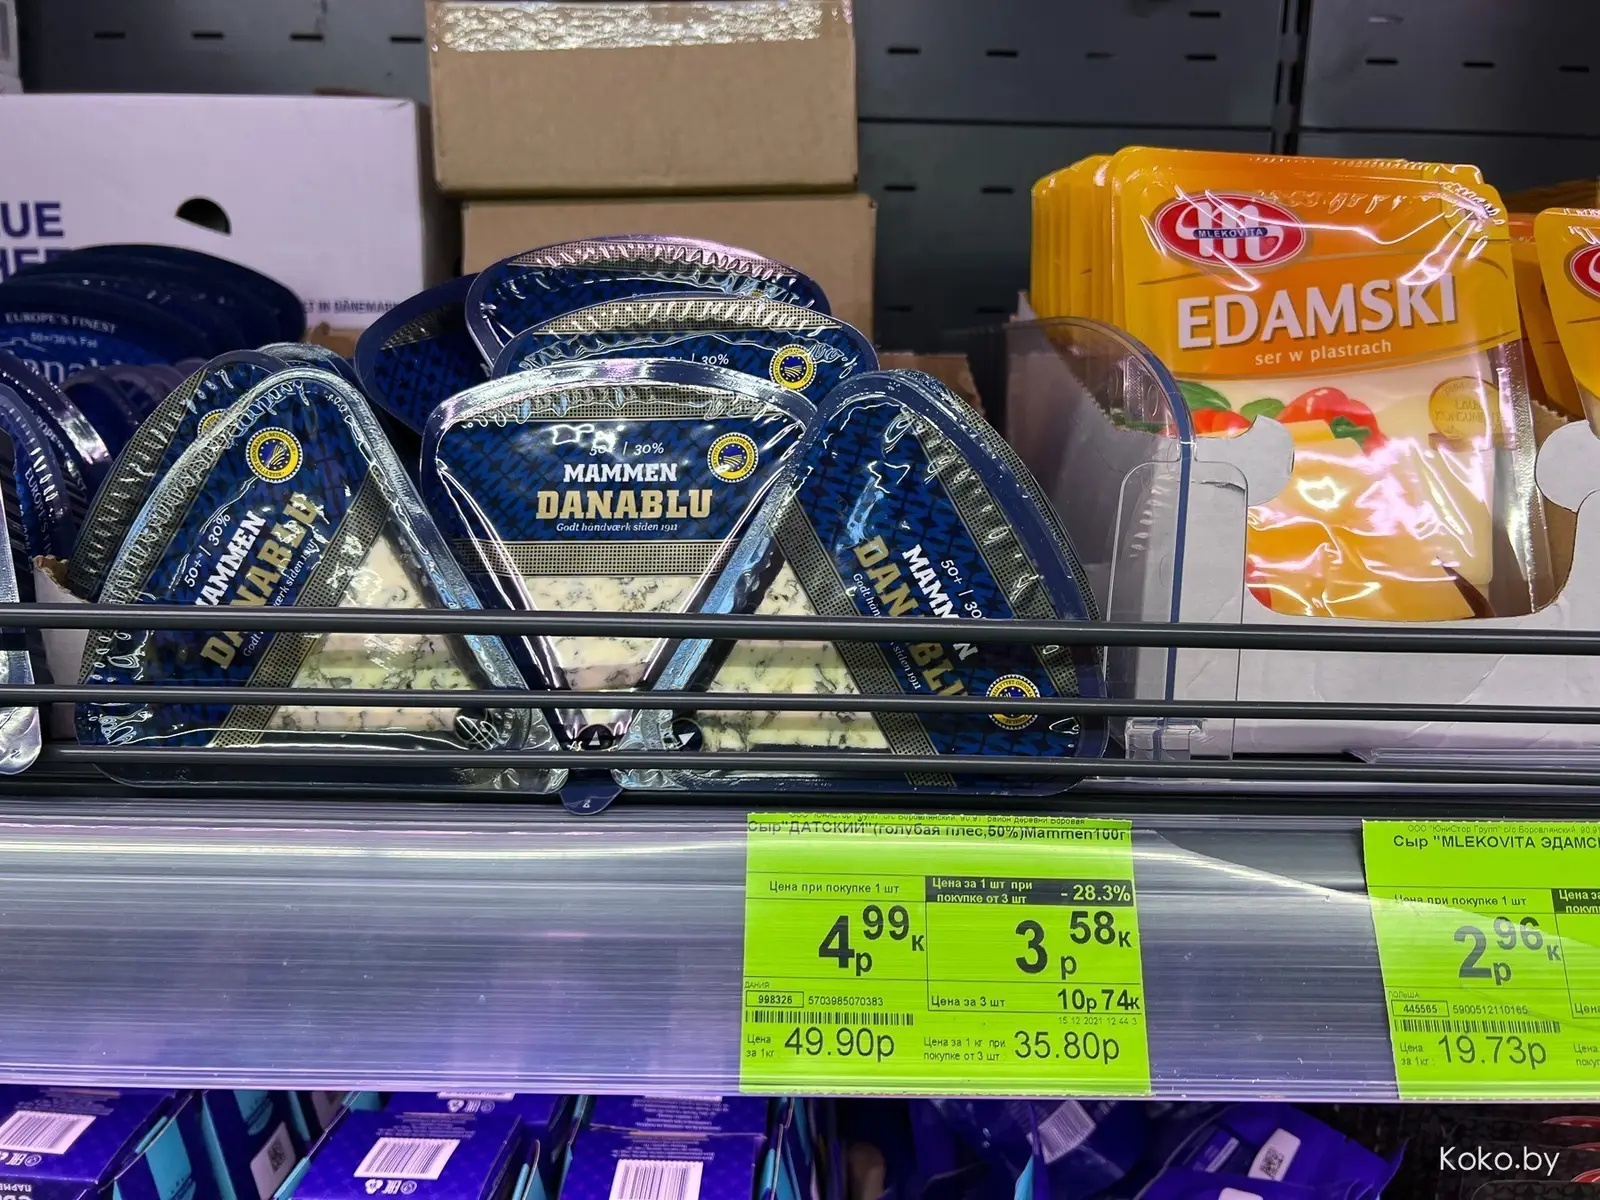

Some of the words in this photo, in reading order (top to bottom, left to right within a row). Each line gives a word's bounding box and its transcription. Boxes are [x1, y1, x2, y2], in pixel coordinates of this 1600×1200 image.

[1198, 228, 1264, 239] MLEKOVITA
[1177, 272, 1457, 349] EDAMSKI
[1255, 352, 1282, 366] ser
[1288, 350, 1304, 362] w
[1310, 339, 1392, 363] plastrach
[633, 442, 665, 455] 30%
[563, 463, 678, 483] MAMMEN
[535, 489, 713, 520] DANABLU
[556, 522, 580, 533] Godt
[633, 522, 659, 532] siden
[660, 524, 678, 533] 1911
[185, 551, 204, 588] 50+
[208, 513, 231, 547] 30%
[285, 558, 304, 588] siden
[852, 573, 872, 598] Godt
[940, 559, 963, 585] 50+
[964, 600, 987, 619] 30
[1393, 835, 1428, 849] Сыр
[1433, 836, 1536, 849] "MLEKOVITA
[769, 880, 798, 893] Цена
[801, 883, 823, 895] при
[826, 883, 871, 895] покупке
[876, 883, 881, 893] 1
[884, 885, 900, 894] шт
[932, 877, 962, 889] Цена
[964, 880, 976, 888] за
[980, 879, 985, 888] 1
[989, 880, 1006, 889] шт
[1011, 880, 1033, 892] при
[937, 893, 983, 903] покупке
[986, 895, 999, 904] от
[1002, 894, 1008, 903] 3
[1011, 896, 1027, 904] шт
[1073, 884, 1131, 901] 28.3%
[1558, 889, 1589, 902] Цена
[1452, 897, 1498, 908] покупке
[1501, 896, 1507, 905] 1
[1511, 897, 1527, 906] шт
[745, 981, 770, 989] ДАНИЯ
[758, 995, 793, 1005] 998326
[808, 995, 884, 1007] 5703985070383
[931, 996, 960, 1008] Цена
[964, 998, 977, 1006] за
[980, 997, 987, 1006] 3
[990, 999, 1005, 1007] шт
[1388, 991, 1420, 999] ПОЛЬША
[1452, 1005, 1528, 1015] 5900512110165
[747, 1035, 772, 1045] Цена
[784, 1026, 895, 1063] 49.90р
[923, 1036, 949, 1048] Цена
[951, 1039, 962, 1048] за
[965, 1037, 970, 1047] 1
[973, 1040, 983, 1048] кг
[989, 1040, 1006, 1050] при
[1013, 1030, 1120, 1065] 35.80р
[746, 1050, 757, 1058] за
[923, 1052, 961, 1063] покупке
[964, 1053, 974, 1061] от
[977, 1052, 984, 1061] 3
[986, 1053, 1000, 1061] шт
[1400, 1041, 1424, 1053] Цена
[1437, 1035, 1547, 1069] 19.73р
[1401, 1058, 1412, 1066] за
